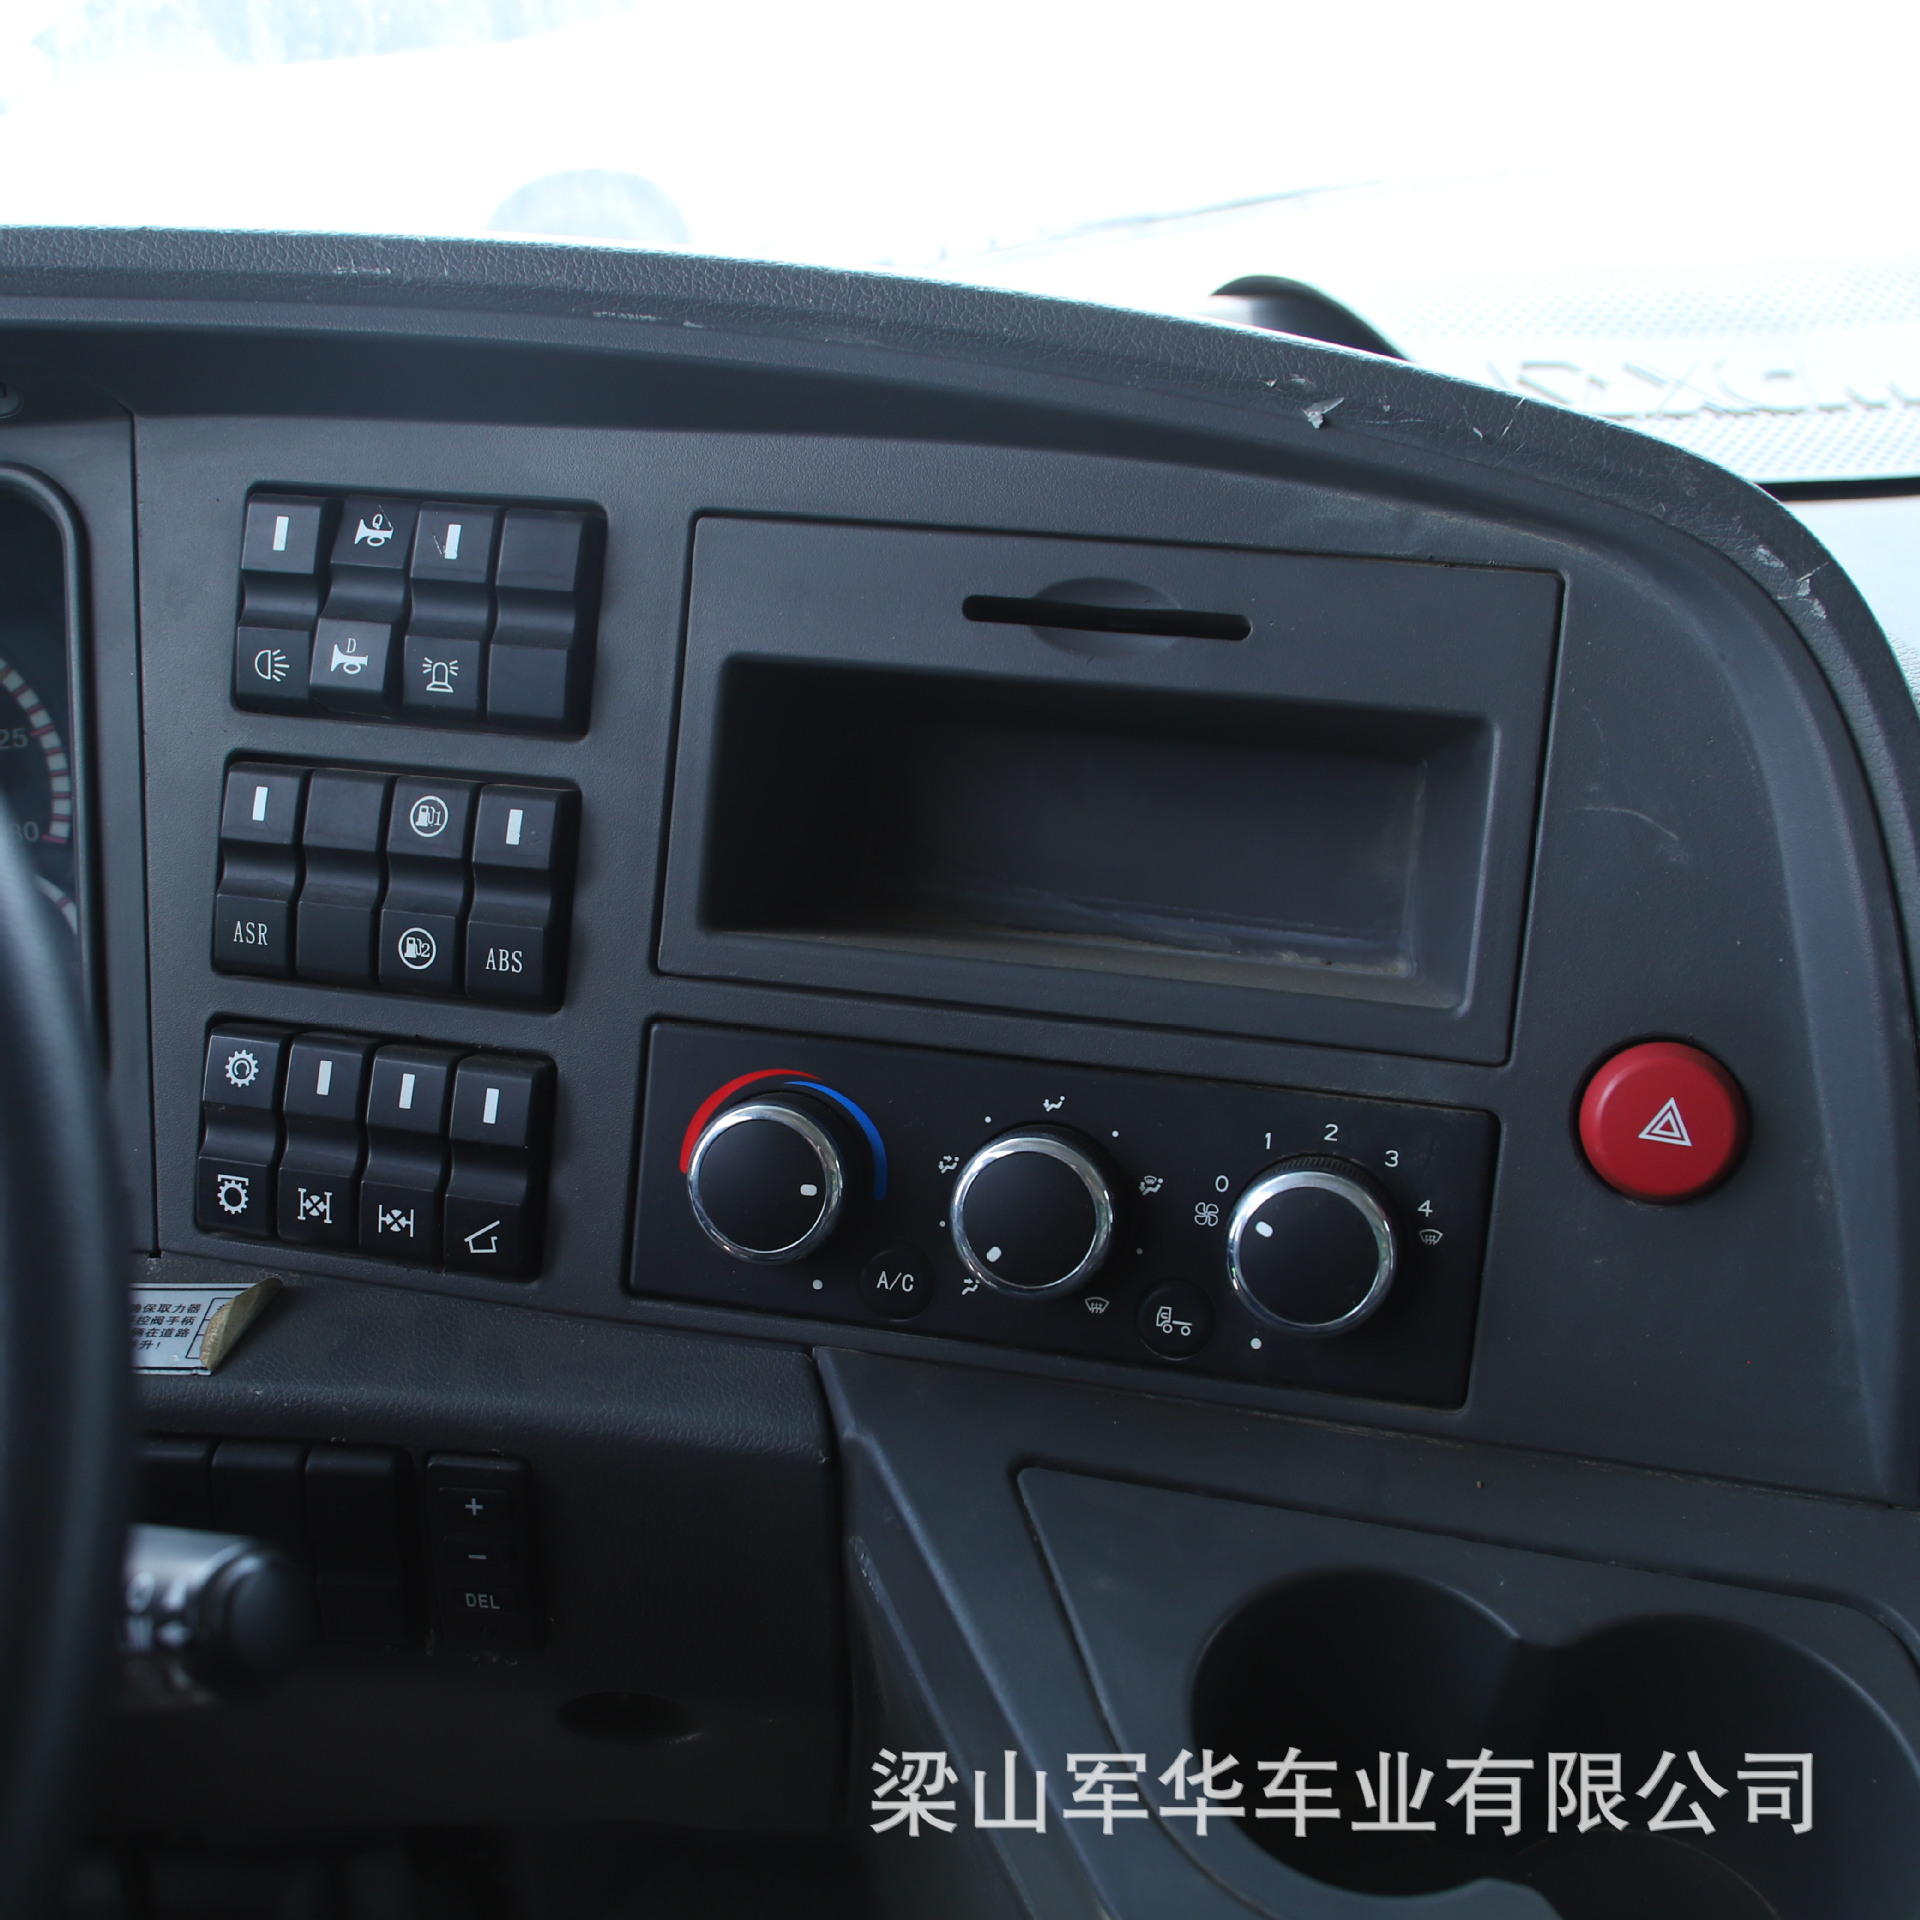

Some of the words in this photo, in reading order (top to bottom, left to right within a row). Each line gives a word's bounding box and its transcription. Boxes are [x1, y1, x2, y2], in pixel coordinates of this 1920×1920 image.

[372, 513, 384, 530] Q
[345, 638, 357, 654] D
[433, 810, 442, 827] 1
[232, 920, 269, 946] ASR
[420, 942, 431, 958] 2
[485, 947, 523, 974] ABS
[1264, 1132, 1272, 1150] 1
[1323, 1123, 1339, 1142] 2
[1384, 1150, 1400, 1168] 3
[1215, 1174, 1230, 1193] 0
[1417, 1199, 1433, 1218] 4
[876, 1270, 914, 1293] A/C
[128, 1315, 196, 1326] 控阀手柄
[465, 1592, 501, 1610] DEL
